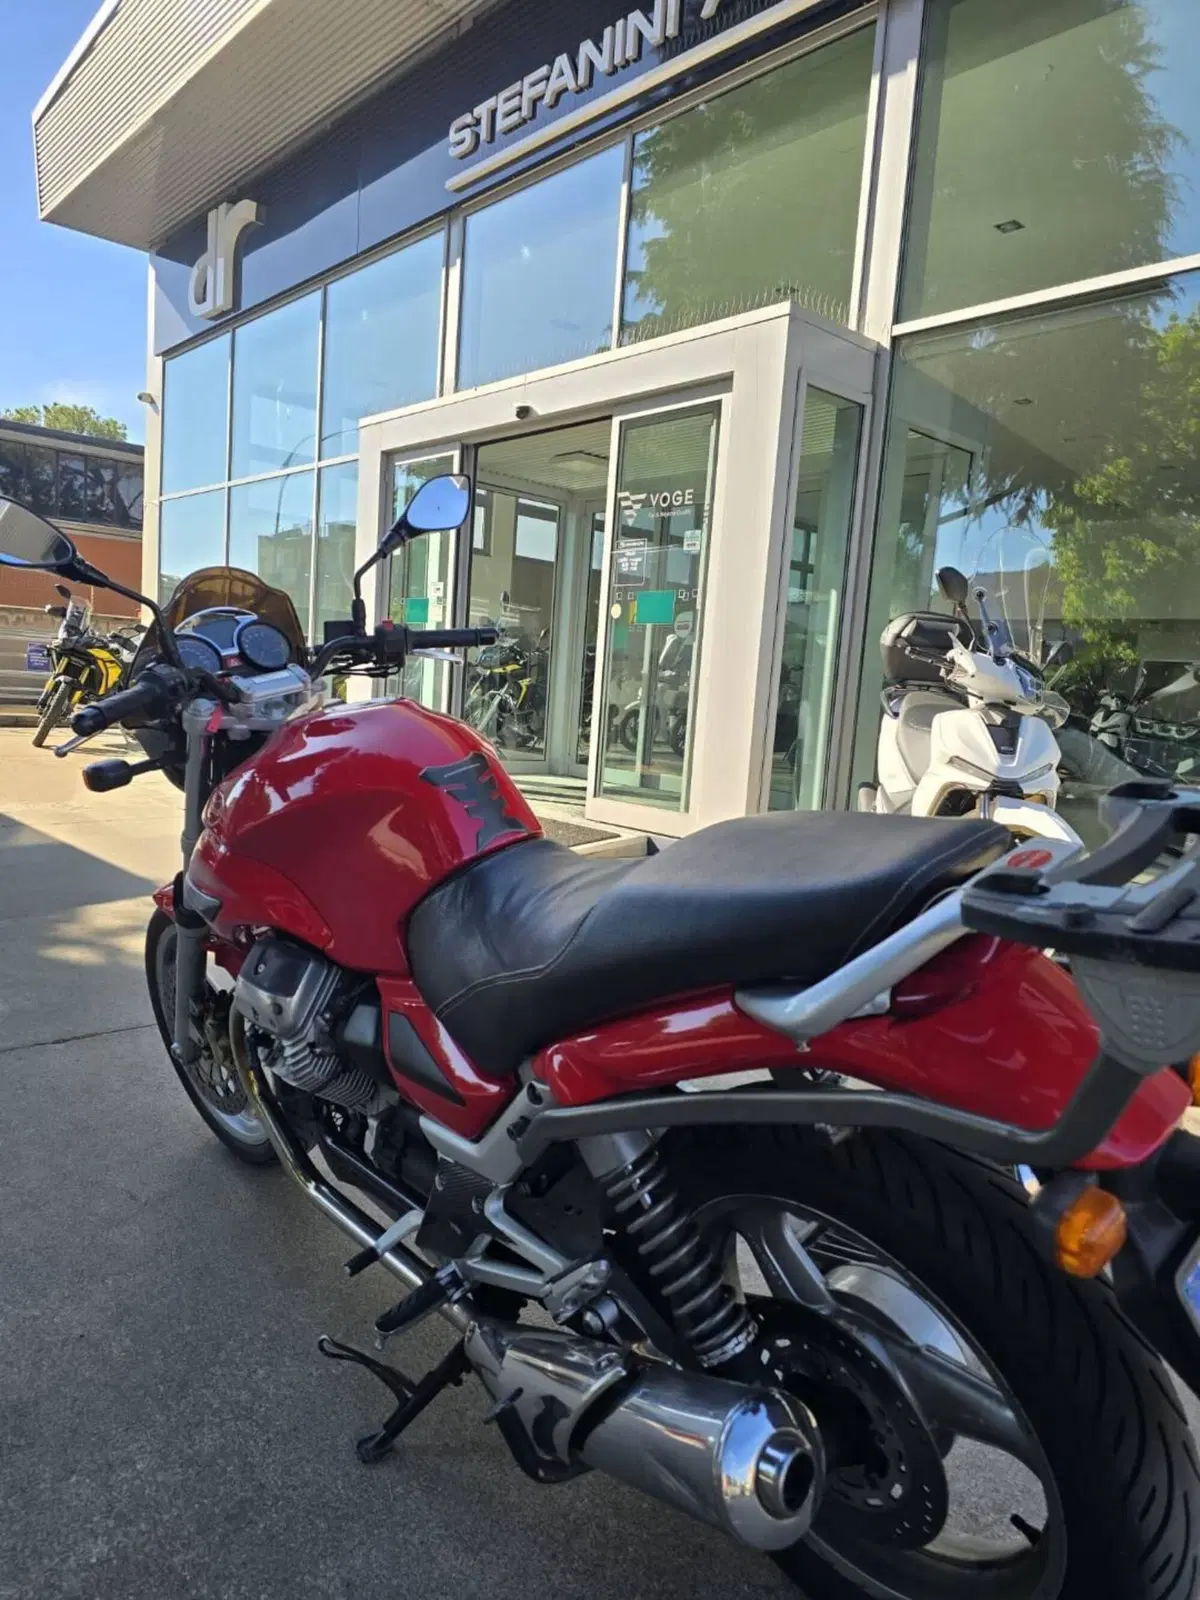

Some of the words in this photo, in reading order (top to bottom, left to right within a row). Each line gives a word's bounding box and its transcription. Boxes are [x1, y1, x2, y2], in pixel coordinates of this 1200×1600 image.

[449, 0, 680, 158] STEFANINI
[188, 199, 262, 319] dr
[650, 489, 694, 508] VOGE
